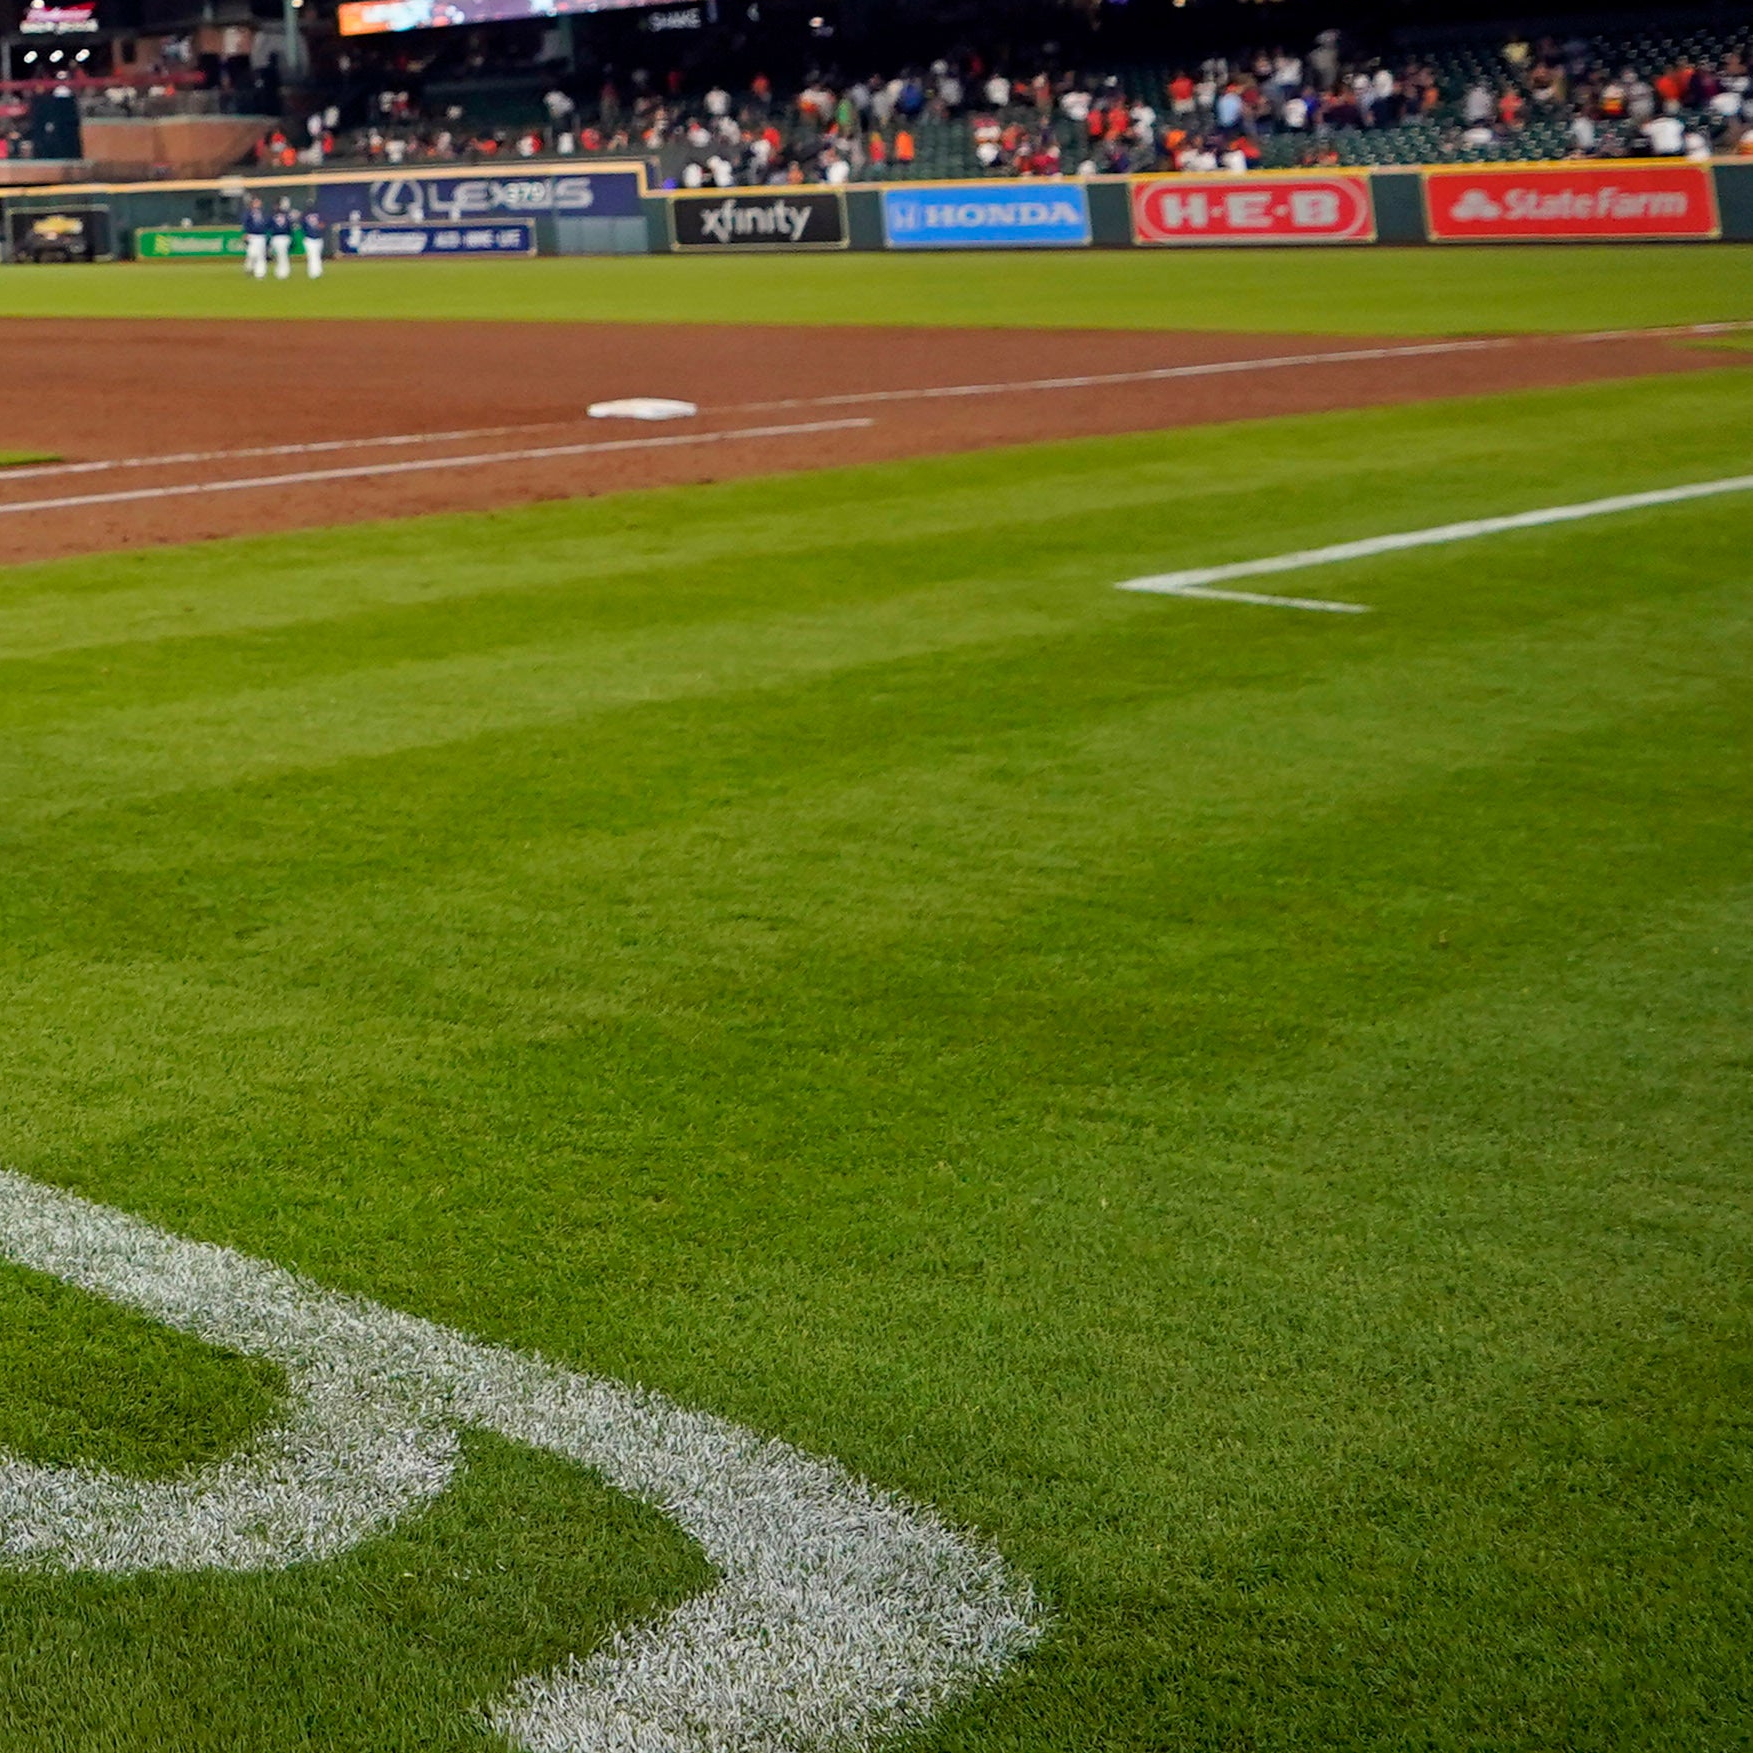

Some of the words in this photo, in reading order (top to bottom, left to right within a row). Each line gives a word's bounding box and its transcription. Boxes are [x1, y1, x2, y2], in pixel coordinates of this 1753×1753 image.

[926, 202, 1081, 229] HONDA
[1596, 186, 1689, 220] Farm
[700, 199, 813, 243] xfinity
